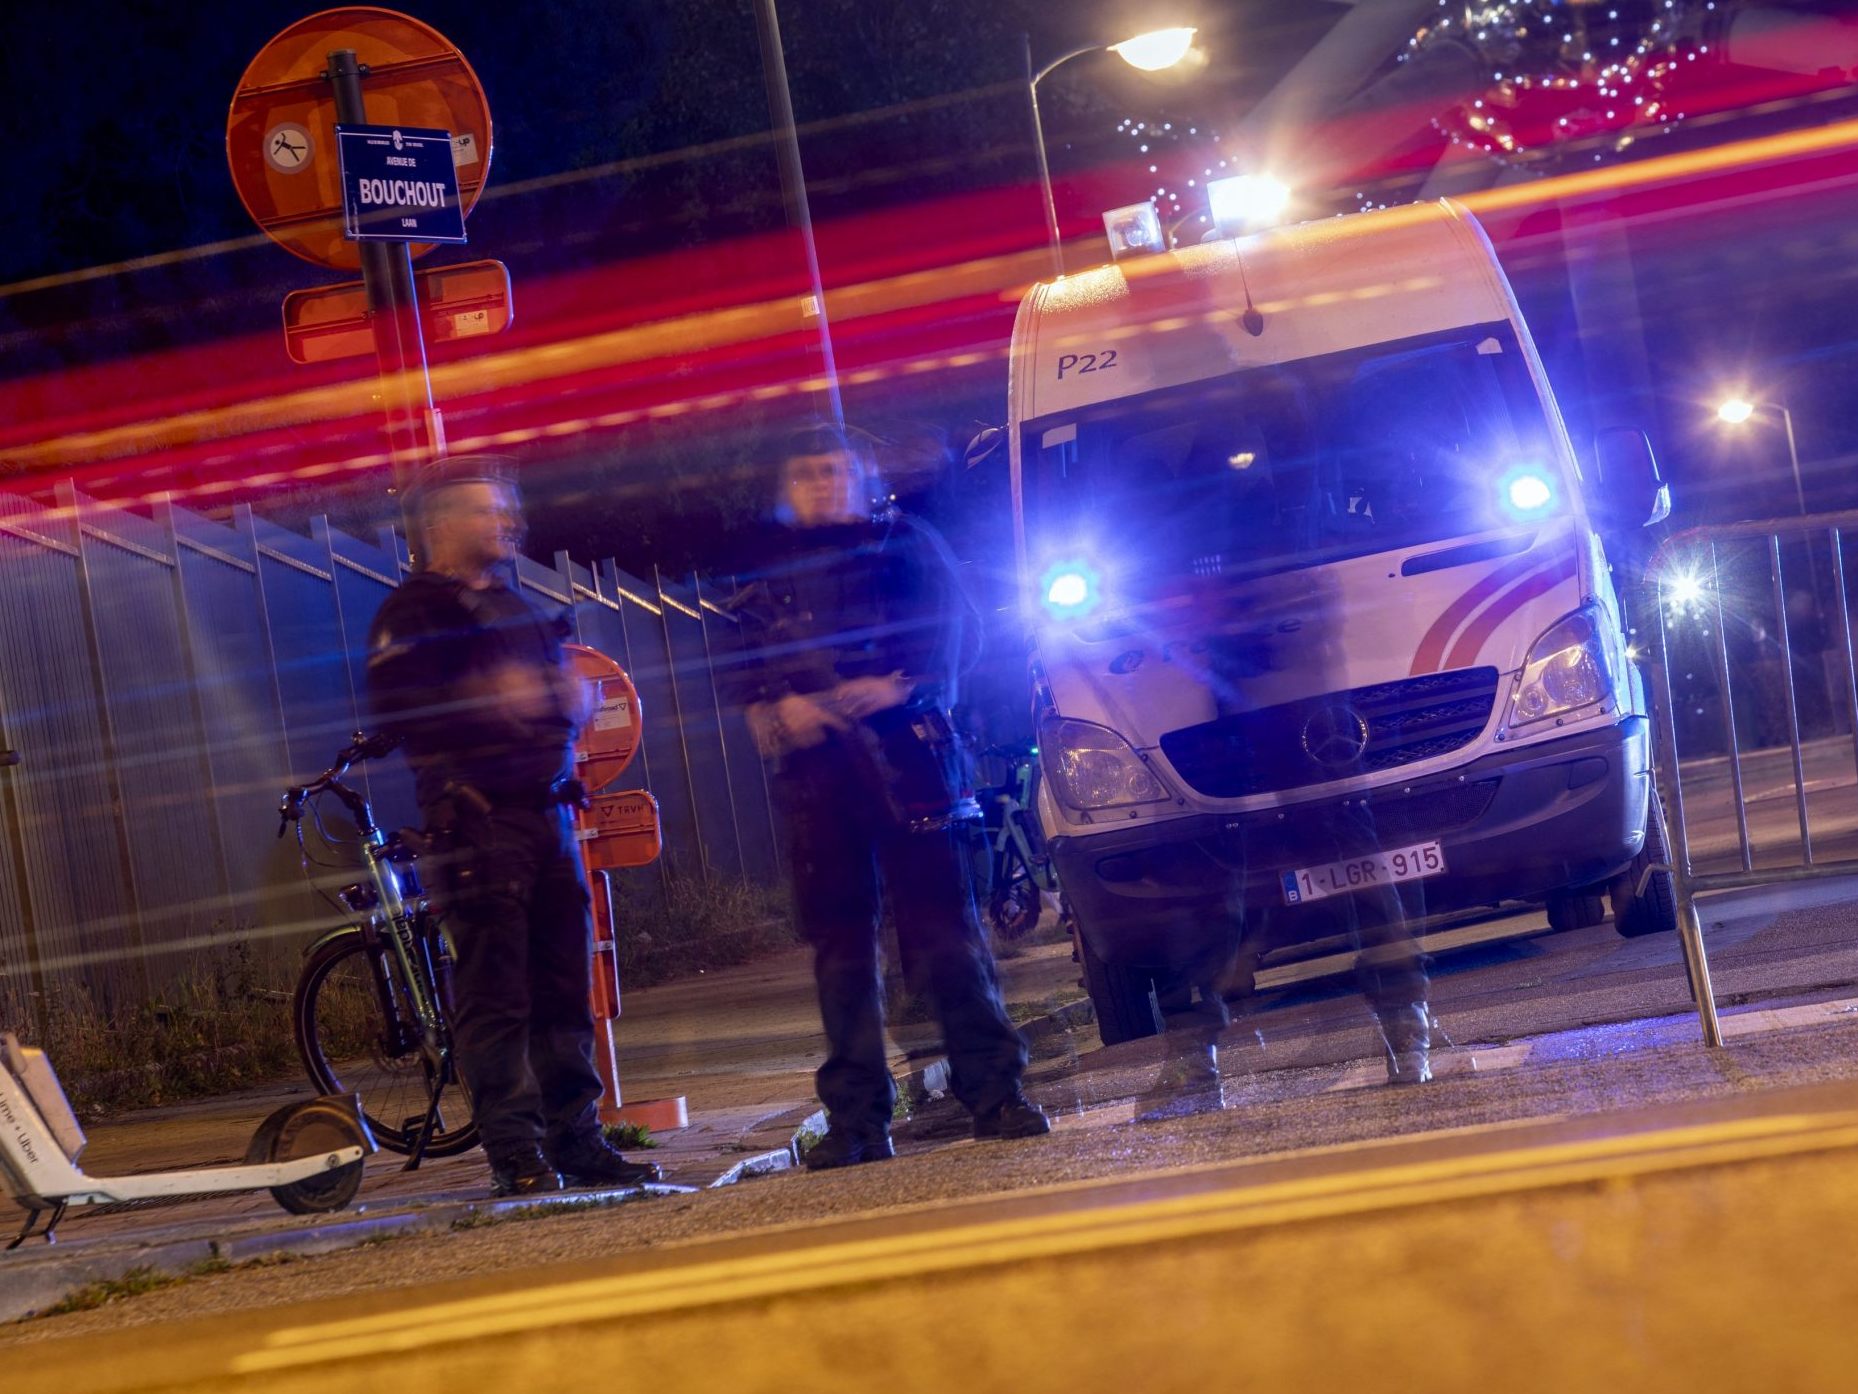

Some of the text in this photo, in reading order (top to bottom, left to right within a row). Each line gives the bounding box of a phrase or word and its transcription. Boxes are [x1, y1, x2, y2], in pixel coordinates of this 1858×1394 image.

[386, 156, 417, 167] AVENUE DE
[359, 178, 446, 208] BOUCHOUT
[401, 218, 418, 228] LAAN
[1057, 349, 1117, 380] P22
[1288, 890, 1298, 901] B
[17, 1132, 39, 1164] Uber
